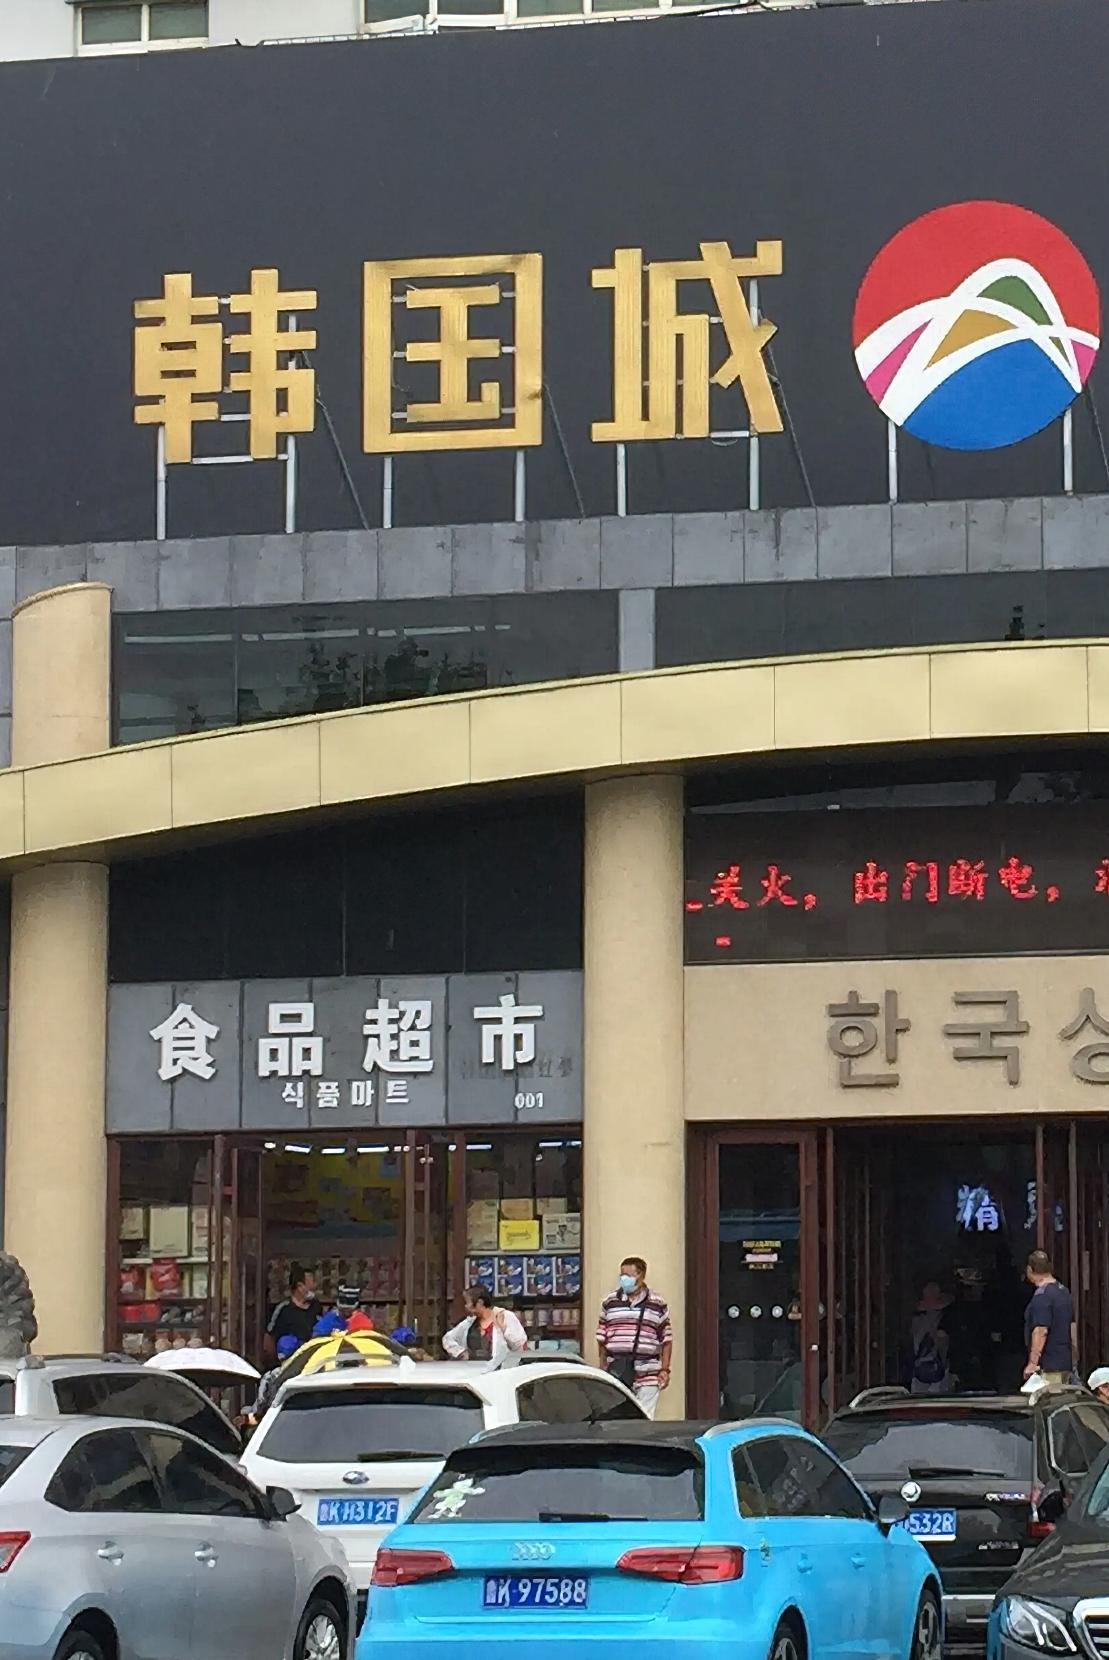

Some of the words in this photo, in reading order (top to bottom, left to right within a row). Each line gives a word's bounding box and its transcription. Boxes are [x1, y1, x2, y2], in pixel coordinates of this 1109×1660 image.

[132, 239, 785, 465] 韩国城
[149, 993, 545, 1082] 食品超市
[281, 1079, 410, 1109] 식품마트
[514, 1092, 544, 1109] 001
